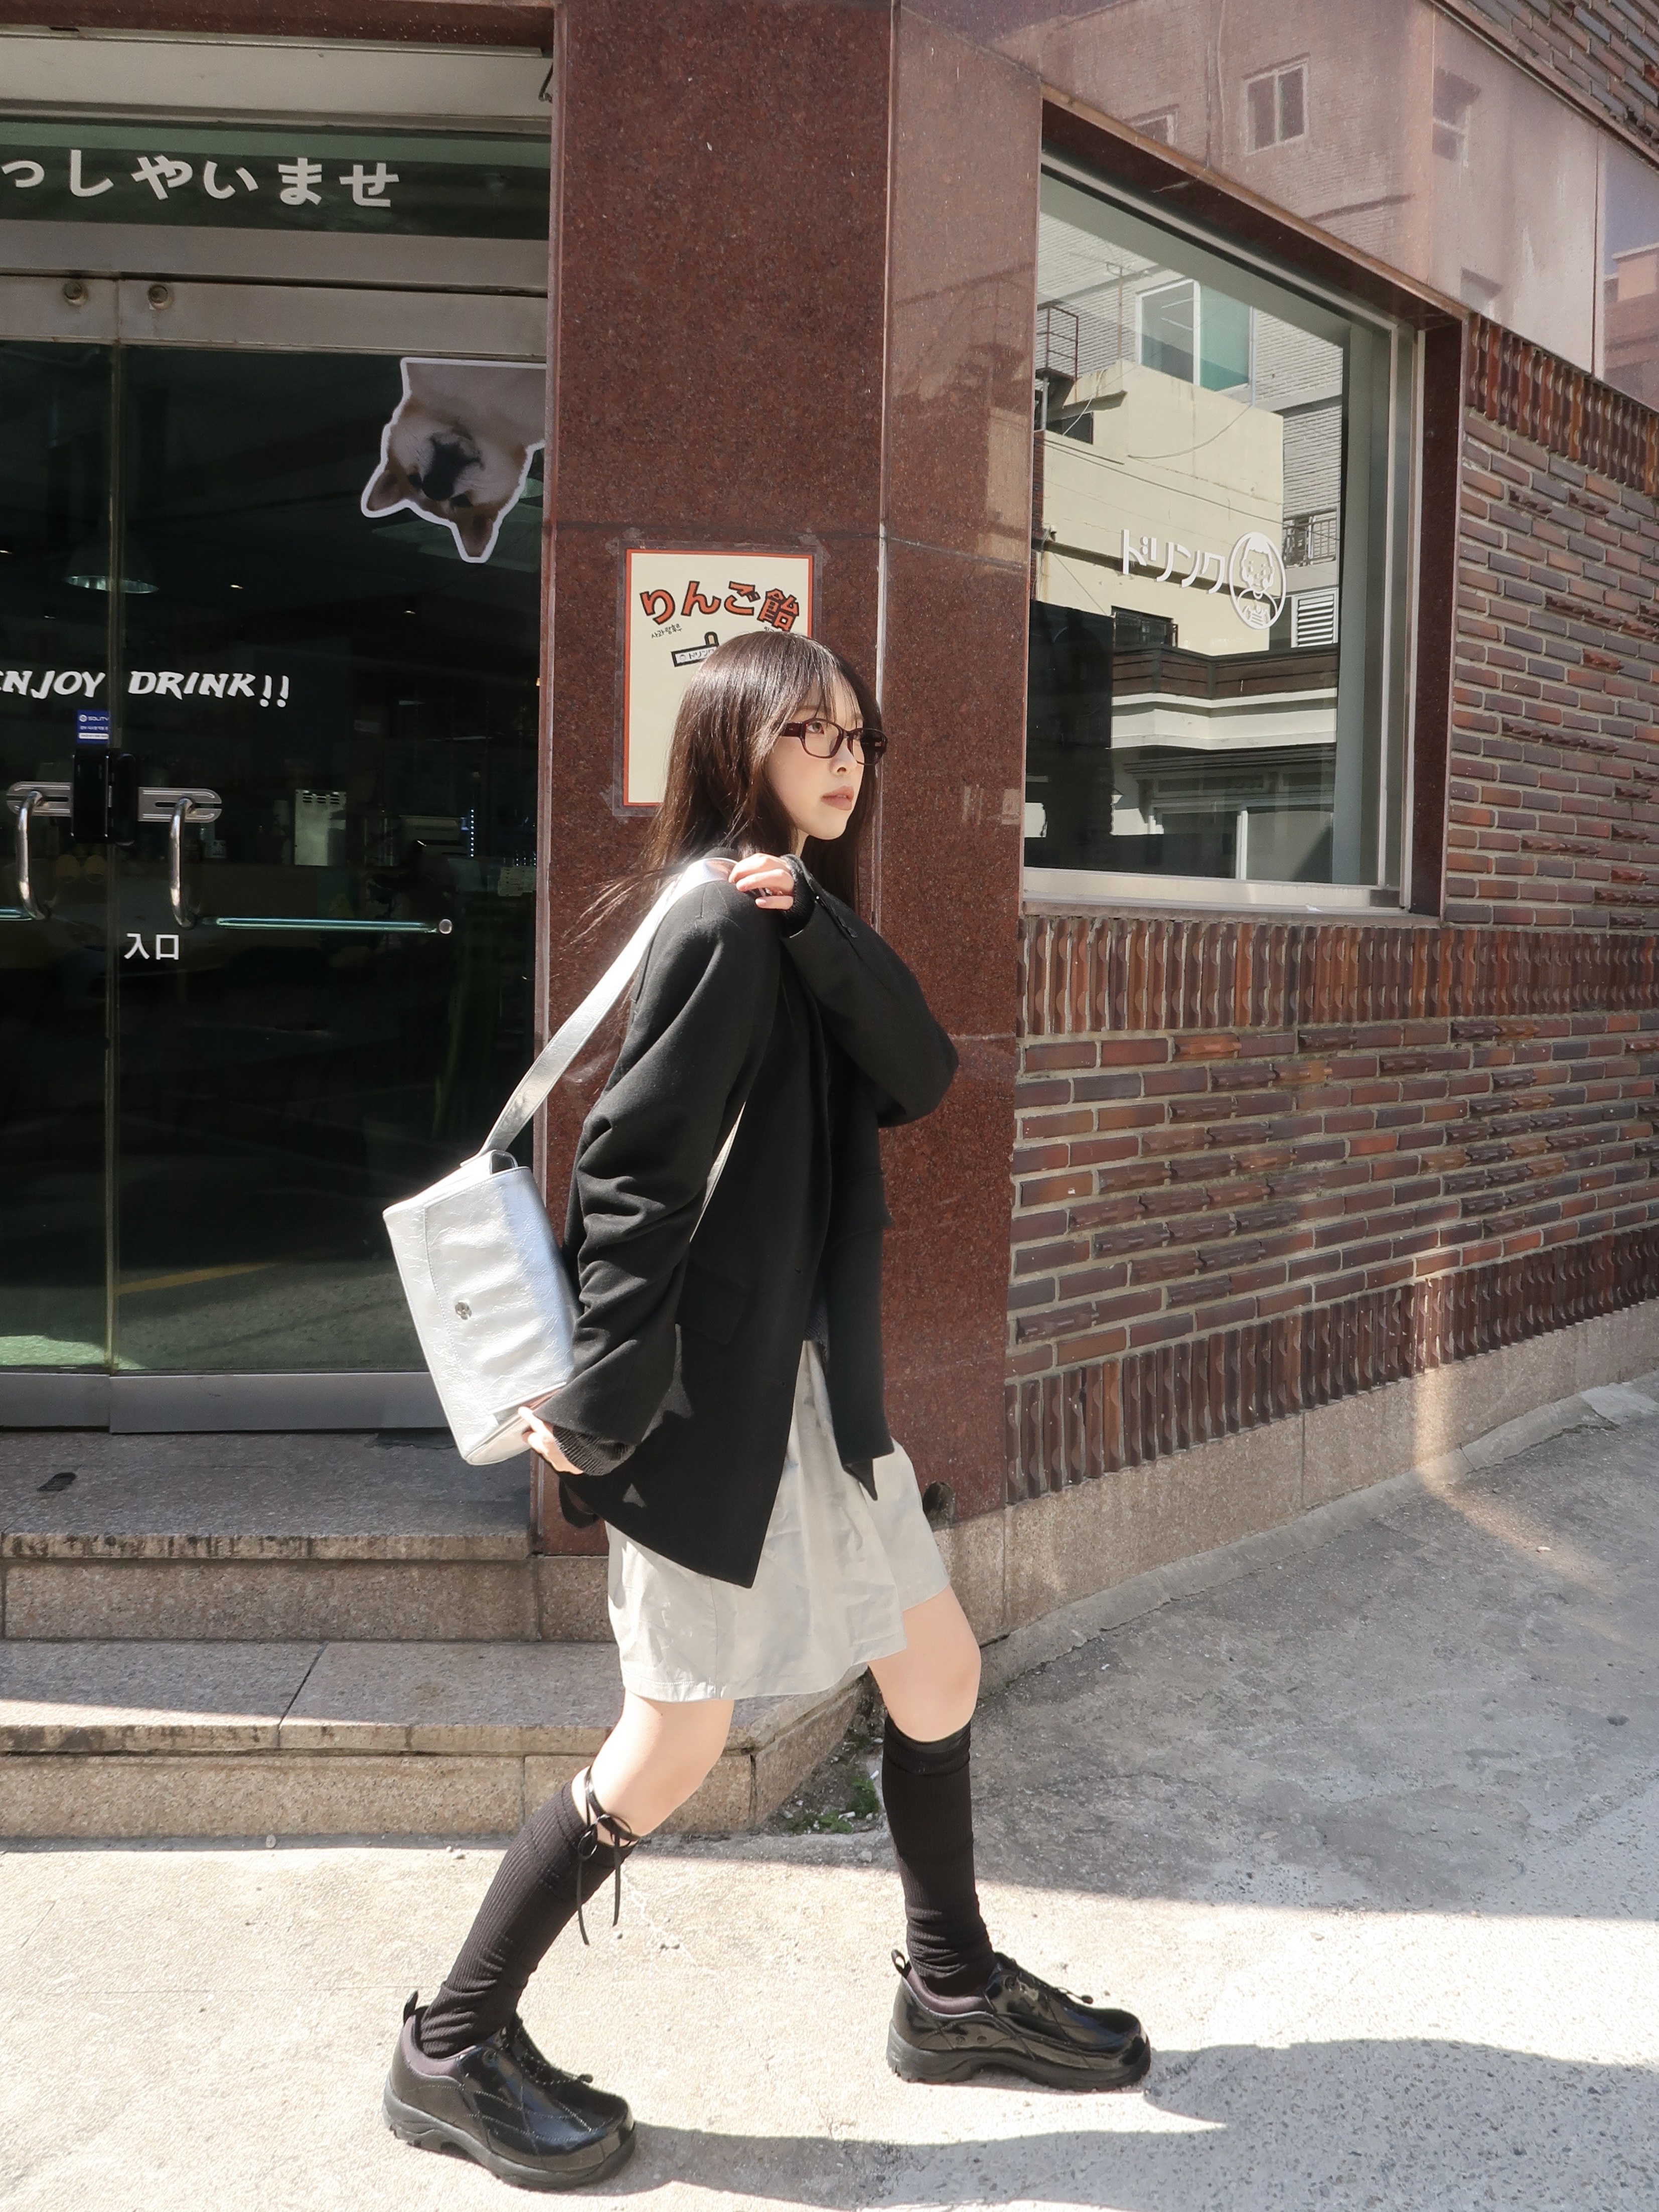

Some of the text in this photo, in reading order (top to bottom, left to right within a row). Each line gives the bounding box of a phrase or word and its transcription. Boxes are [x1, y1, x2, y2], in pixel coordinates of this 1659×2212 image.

[1122, 529, 1226, 594] ドリンク
[639, 580, 800, 631] りんご飴
[0, 670, 289, 707] NJOY DRINK!!
[124, 933, 180, 960] 入口
